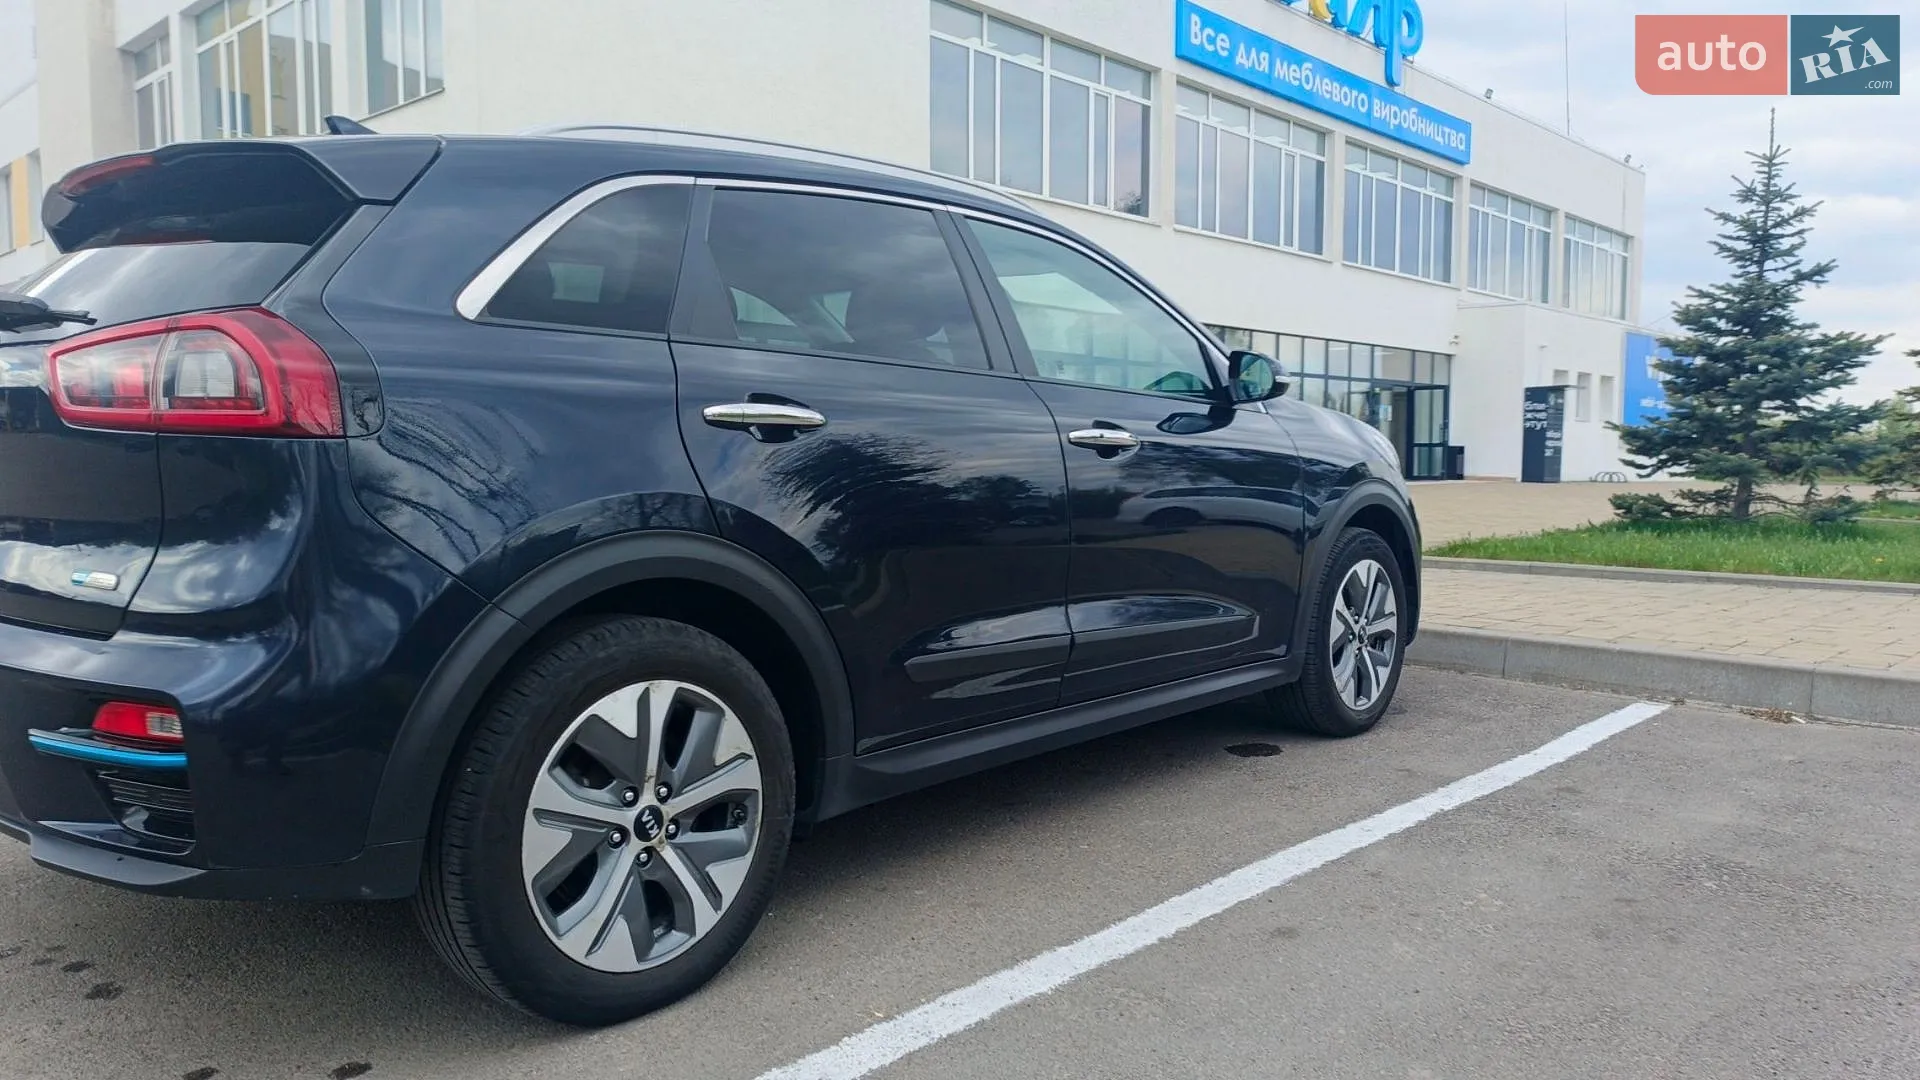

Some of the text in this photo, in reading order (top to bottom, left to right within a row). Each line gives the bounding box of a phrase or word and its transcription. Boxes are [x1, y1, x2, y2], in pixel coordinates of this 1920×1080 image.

[1189, 13, 1231, 57] Все
[1235, 43, 1270, 74] для
[1274, 57, 1369, 113] меблевого
[1373, 96, 1467, 152] виробництва
